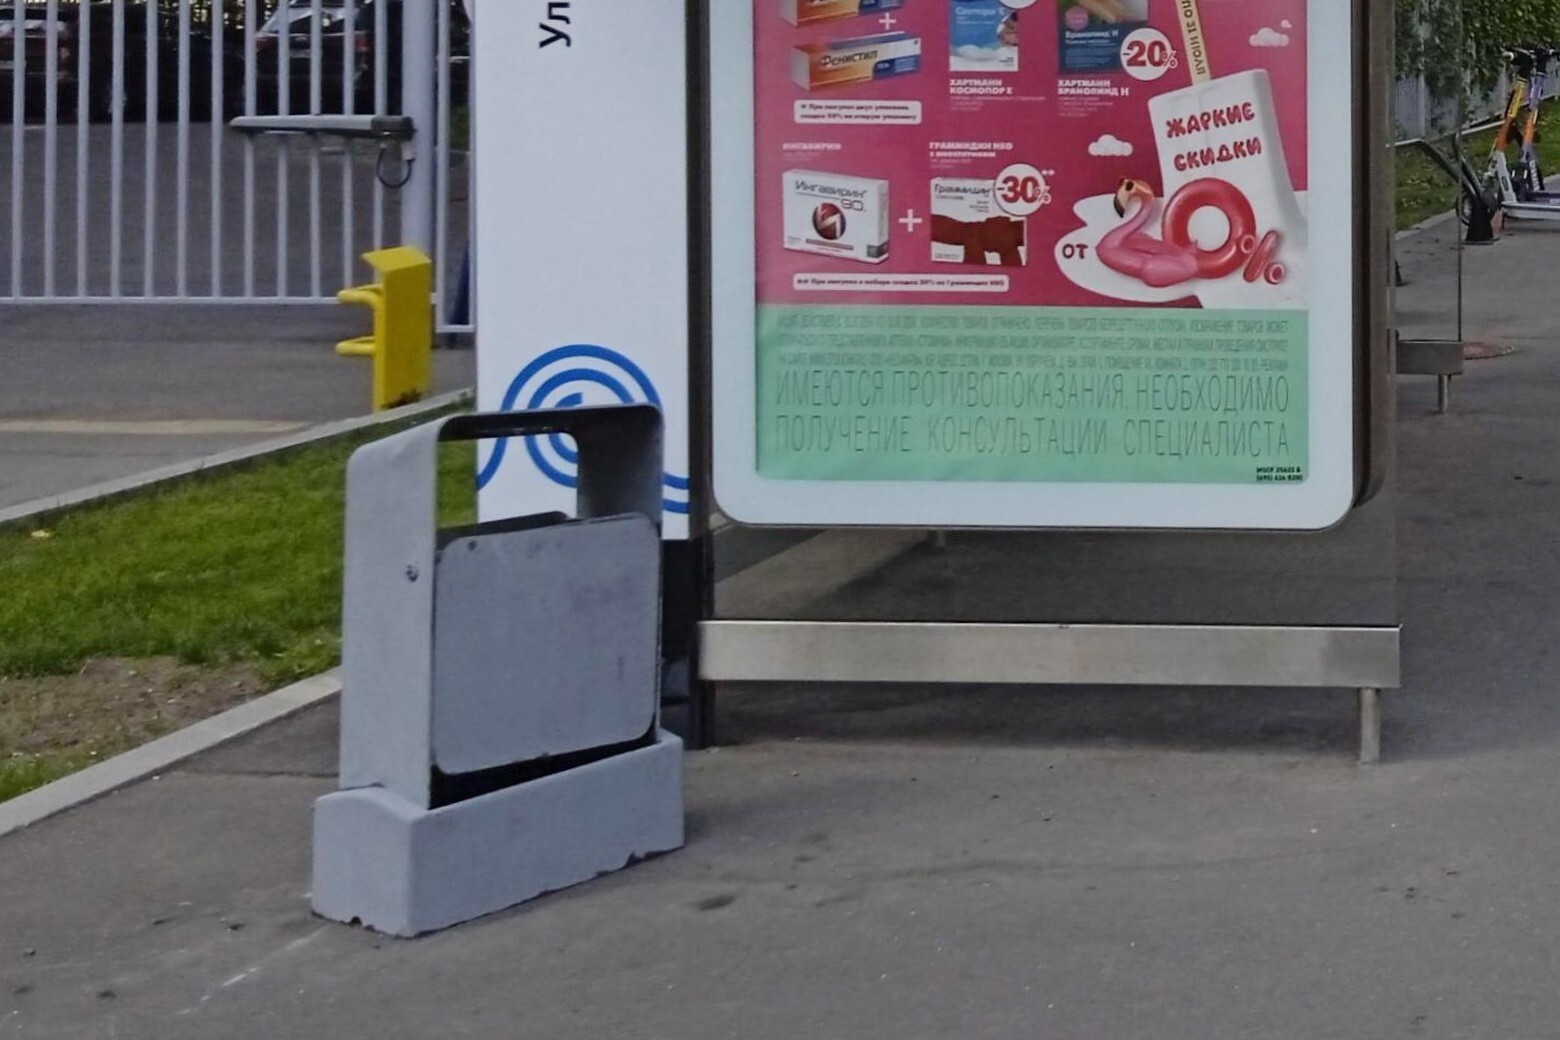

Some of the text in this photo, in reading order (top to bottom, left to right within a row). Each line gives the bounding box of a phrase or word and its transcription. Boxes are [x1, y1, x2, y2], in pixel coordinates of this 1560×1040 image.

[1122, 40, 1177, 69] -20%
[1166, 102, 1255, 138] ЖАРКИЕ
[1173, 137, 1262, 172] СКИДКИ
[794, 179, 867, 200] Ингавирин
[776, 369, 884, 407] ИМЕЮТСЯ
[1136, 374, 1290, 414] НЕОБХОДИМО
[776, 415, 1290, 460] ПОЛУЧЕНИЕ КОНСУЛЬТАЦИИ СПЕЦИАЛИСТА
